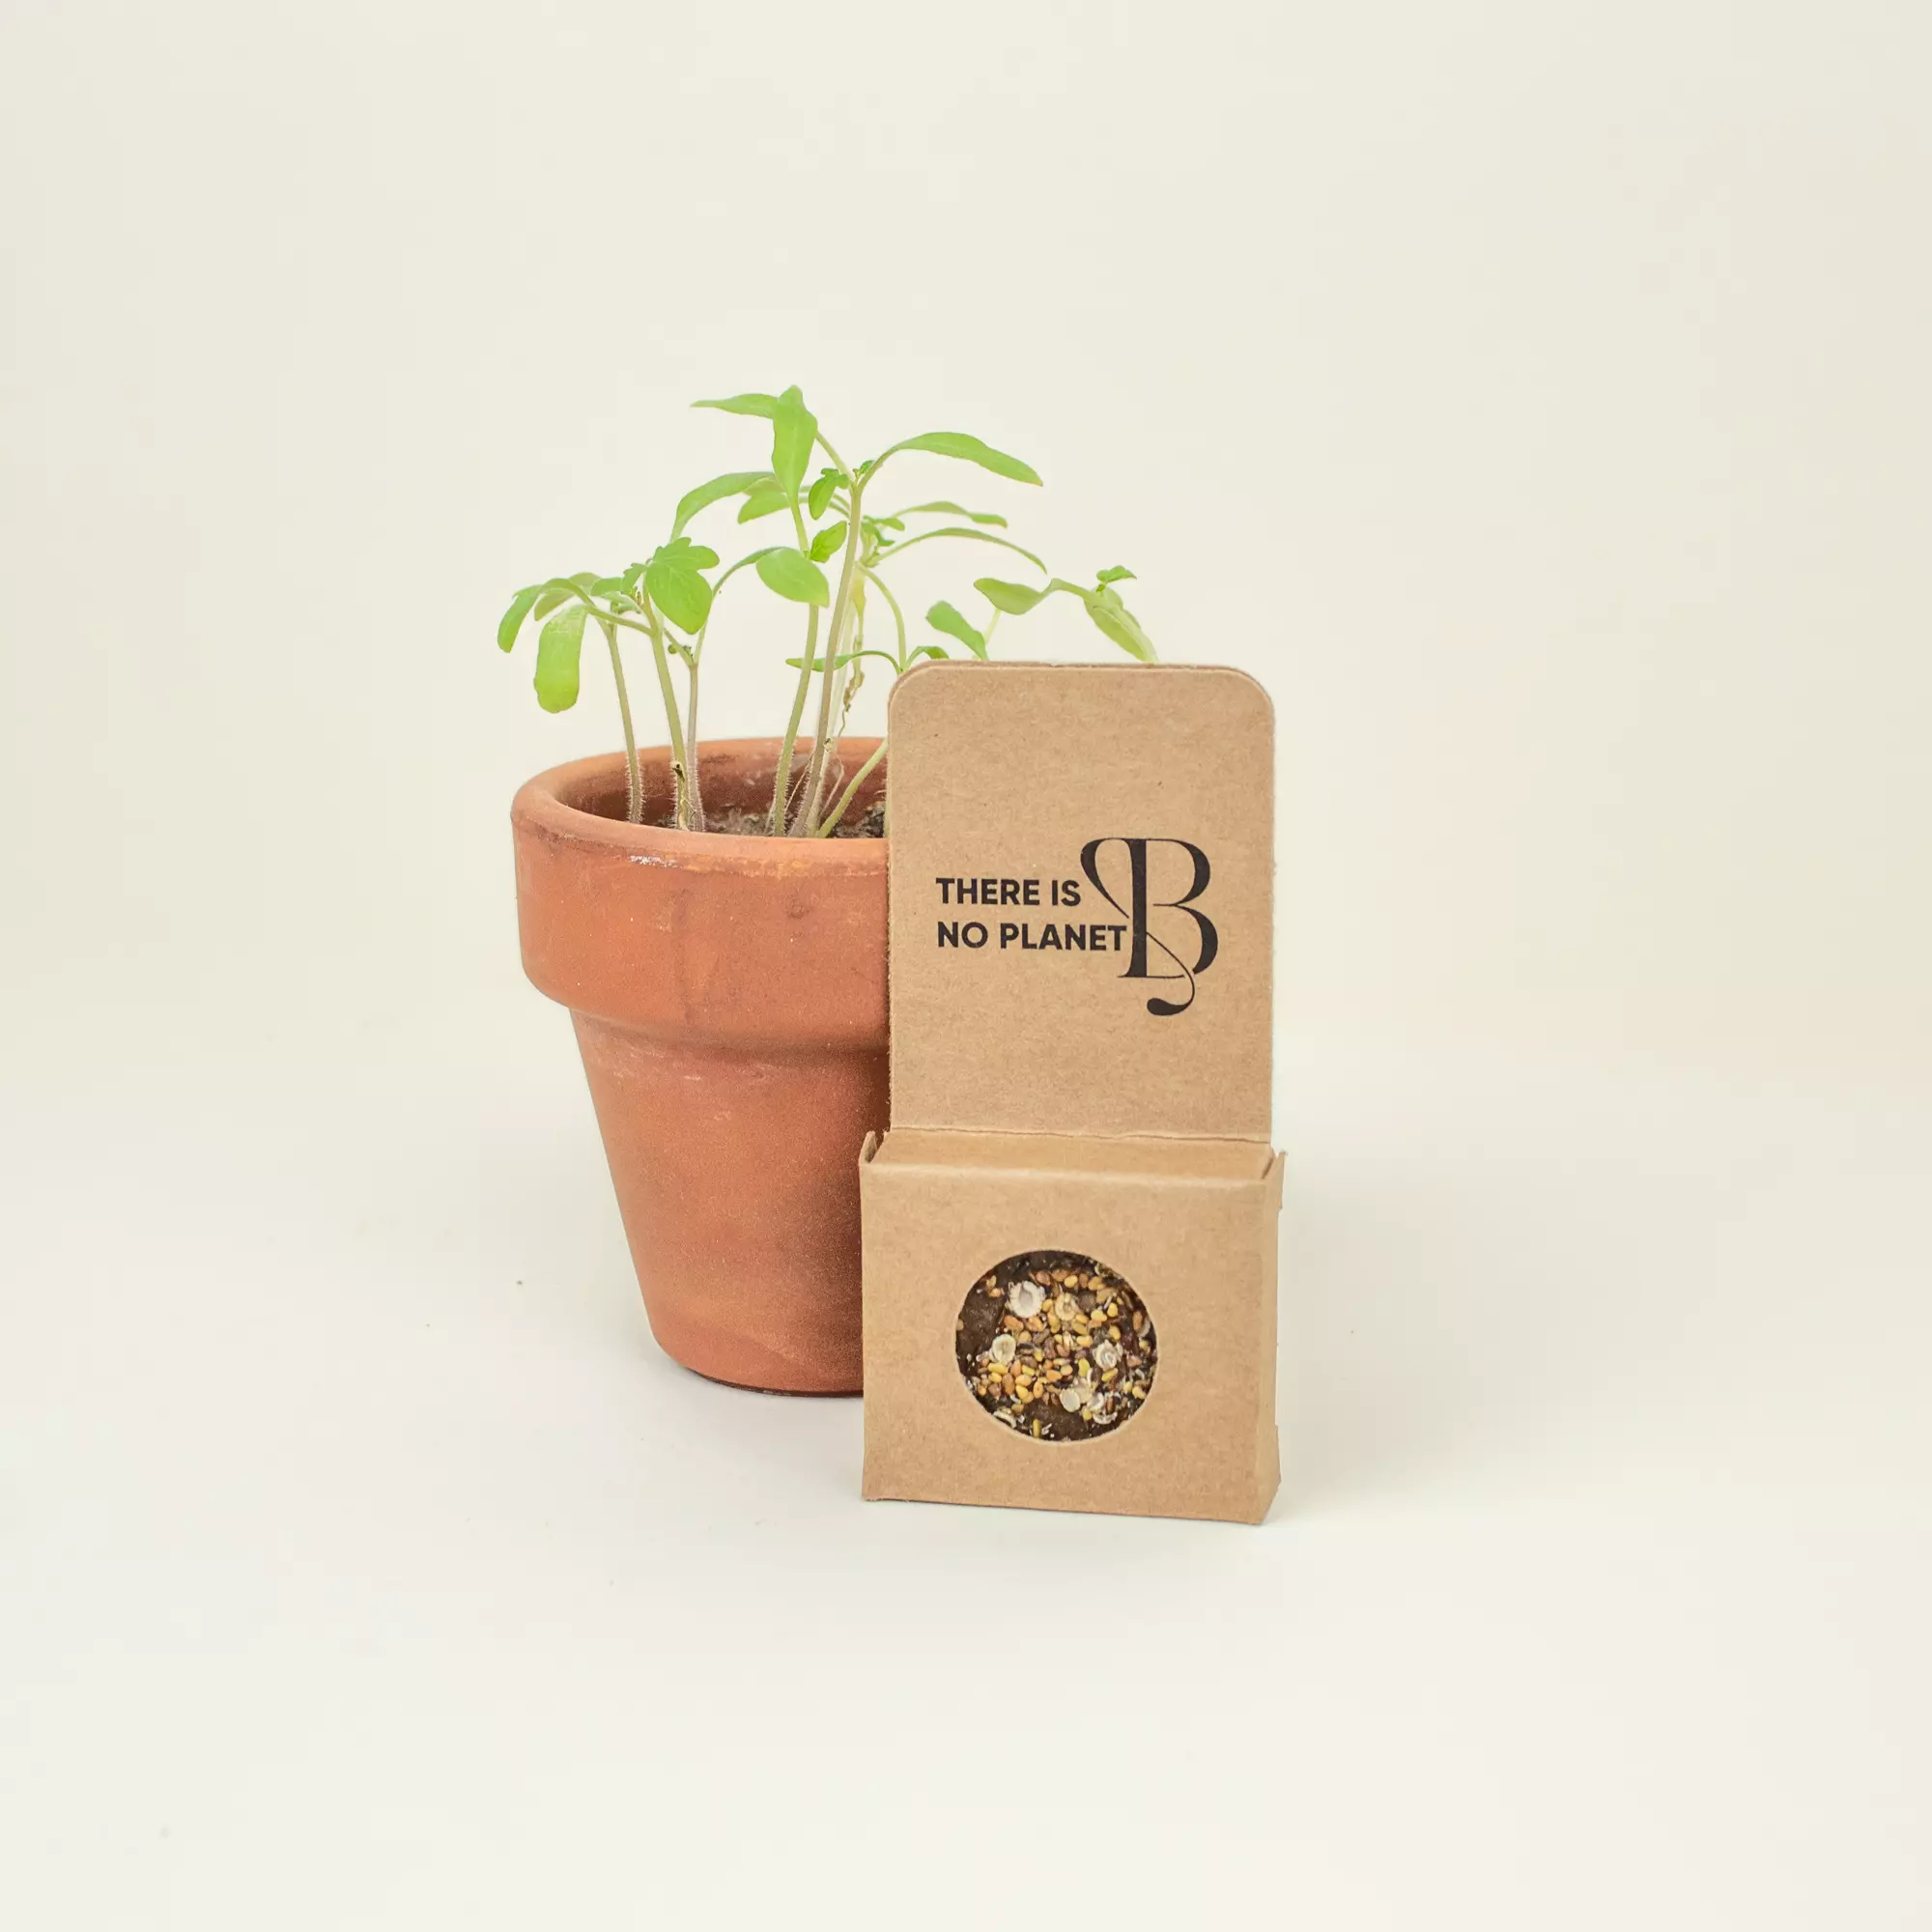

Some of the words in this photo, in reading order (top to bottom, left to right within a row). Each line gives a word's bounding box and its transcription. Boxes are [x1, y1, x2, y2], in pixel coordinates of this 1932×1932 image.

[935, 877, 1040, 906] THERE
[1051, 879, 1081, 907] IS
[937, 921, 988, 949] NO
[1000, 923, 1127, 952] PLANET
[1080, 838, 1219, 1016] B
